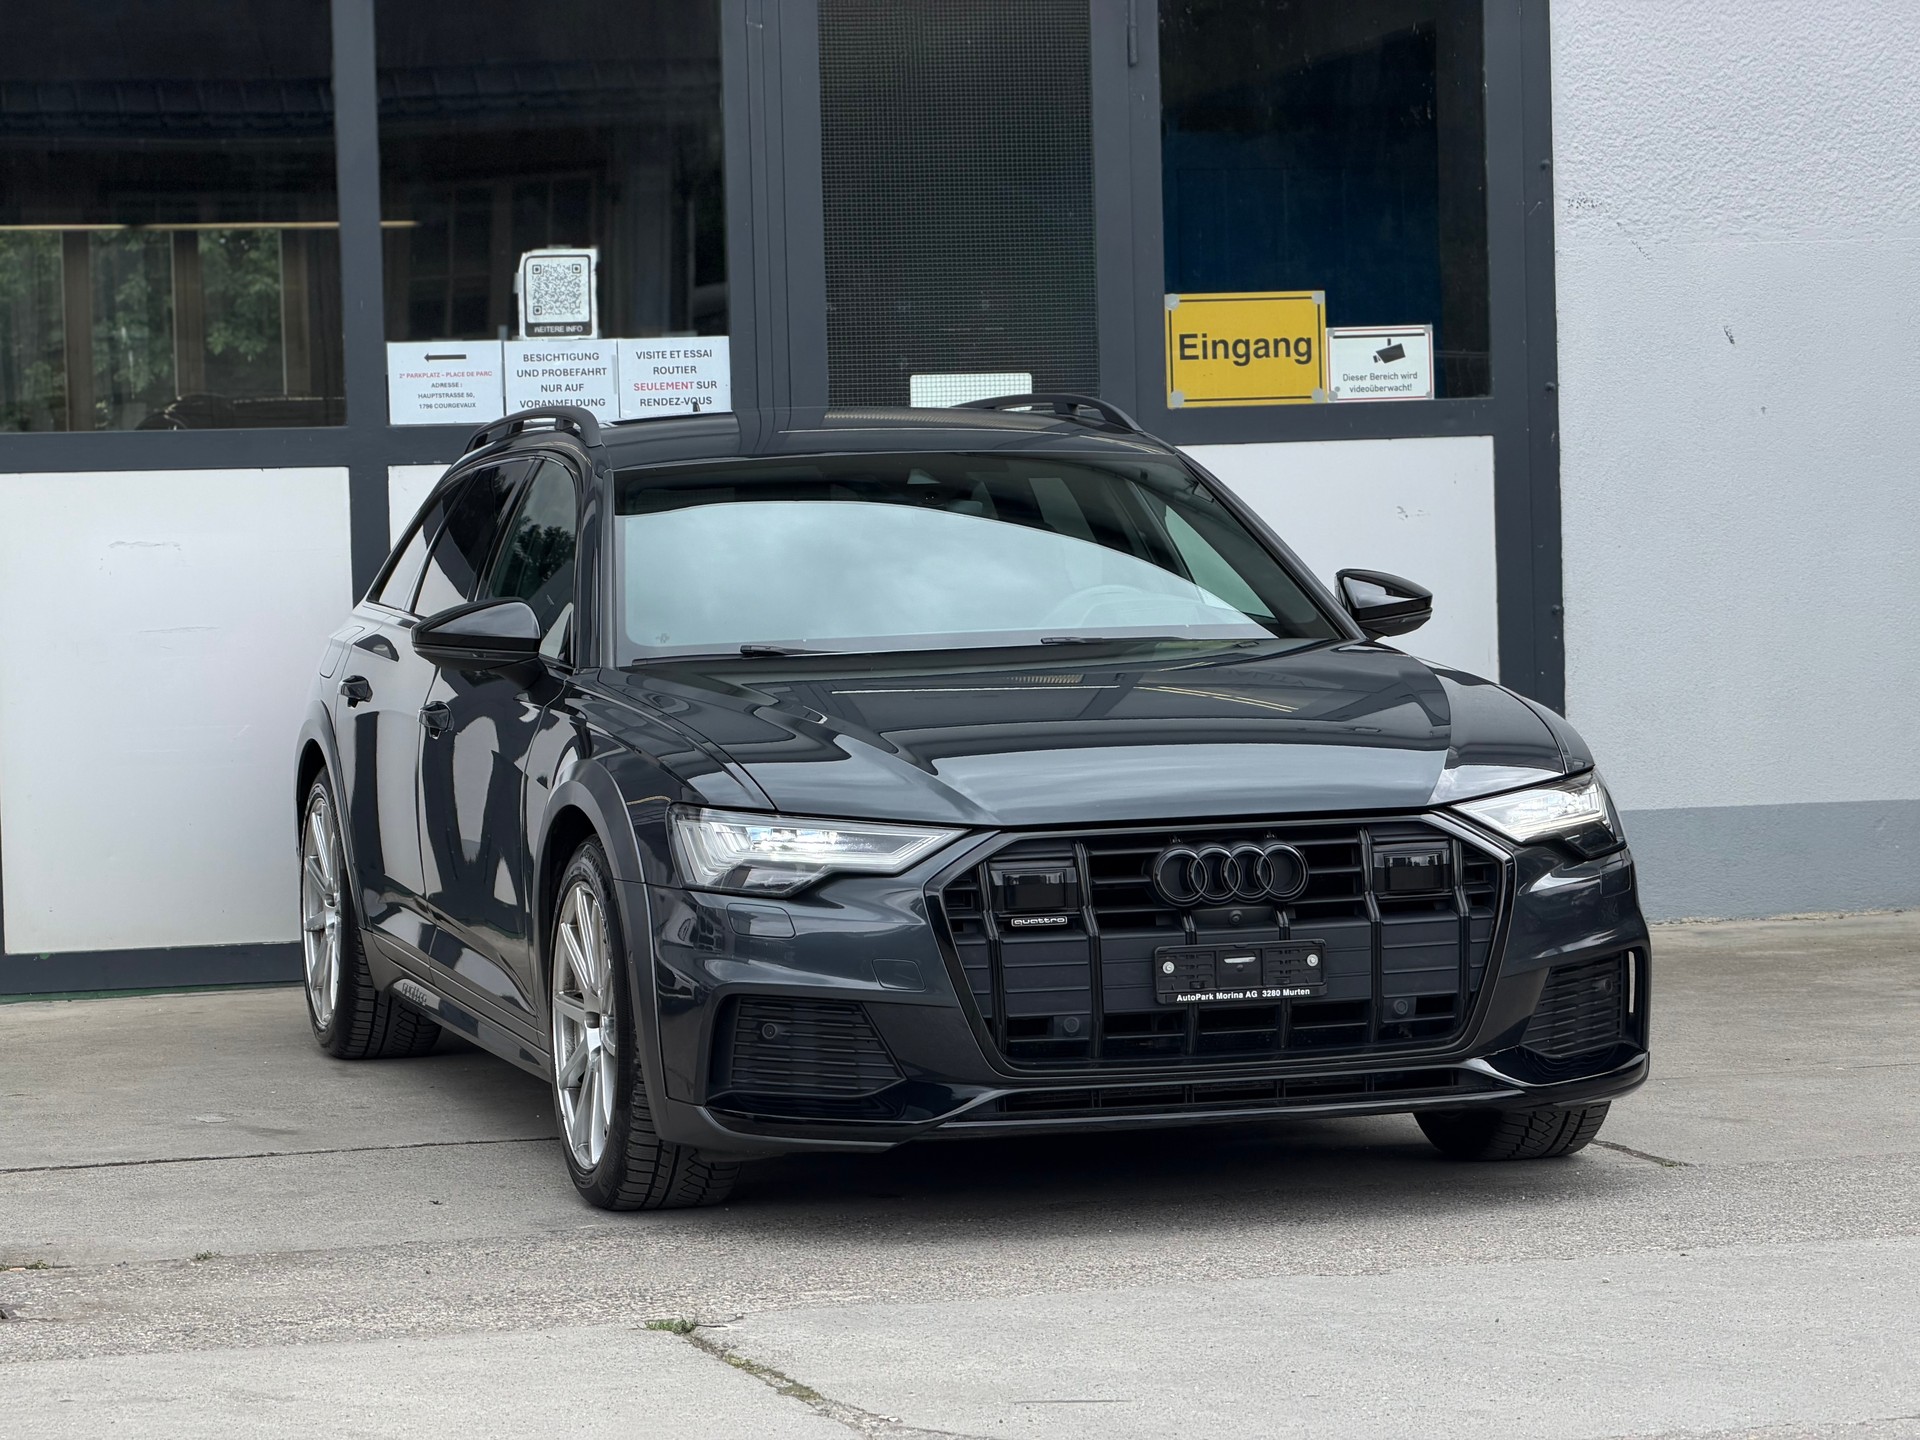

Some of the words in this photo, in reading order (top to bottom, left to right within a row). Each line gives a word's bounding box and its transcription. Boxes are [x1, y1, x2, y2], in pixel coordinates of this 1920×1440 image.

[635, 350, 667, 359] VISITE
[669, 350, 681, 358] ET
[683, 349, 712, 358] ESSAI
[1179, 333, 1312, 366] Eingang
[523, 352, 599, 362] BESICHTIGUNG
[516, 369, 539, 377] UND
[541, 367, 607, 377] PROBEFAHRT
[653, 365, 697, 375] ROUTIER
[1342, 373, 1367, 382] Dieser
[1369, 372, 1399, 380] Bereich
[1400, 371, 1418, 380] wird
[540, 384, 563, 393] NUR
[564, 383, 584, 392] AUF
[633, 381, 694, 392] SEULEMENT
[696, 381, 717, 389] SUR
[1349, 383, 1412, 393] videoüberwacht!
[520, 398, 606, 408] VORANMELDUNG
[640, 396, 713, 407] RENDEZ-VOUS
[1014, 917, 1065, 925] quattro
[1176, 994, 1214, 1002] AutoPark
[1216, 991, 1243, 1000] Morina
[1245, 990, 1258, 998] AG
[1262, 989, 1281, 997] 3280
[1282, 988, 1311, 996] Murten
